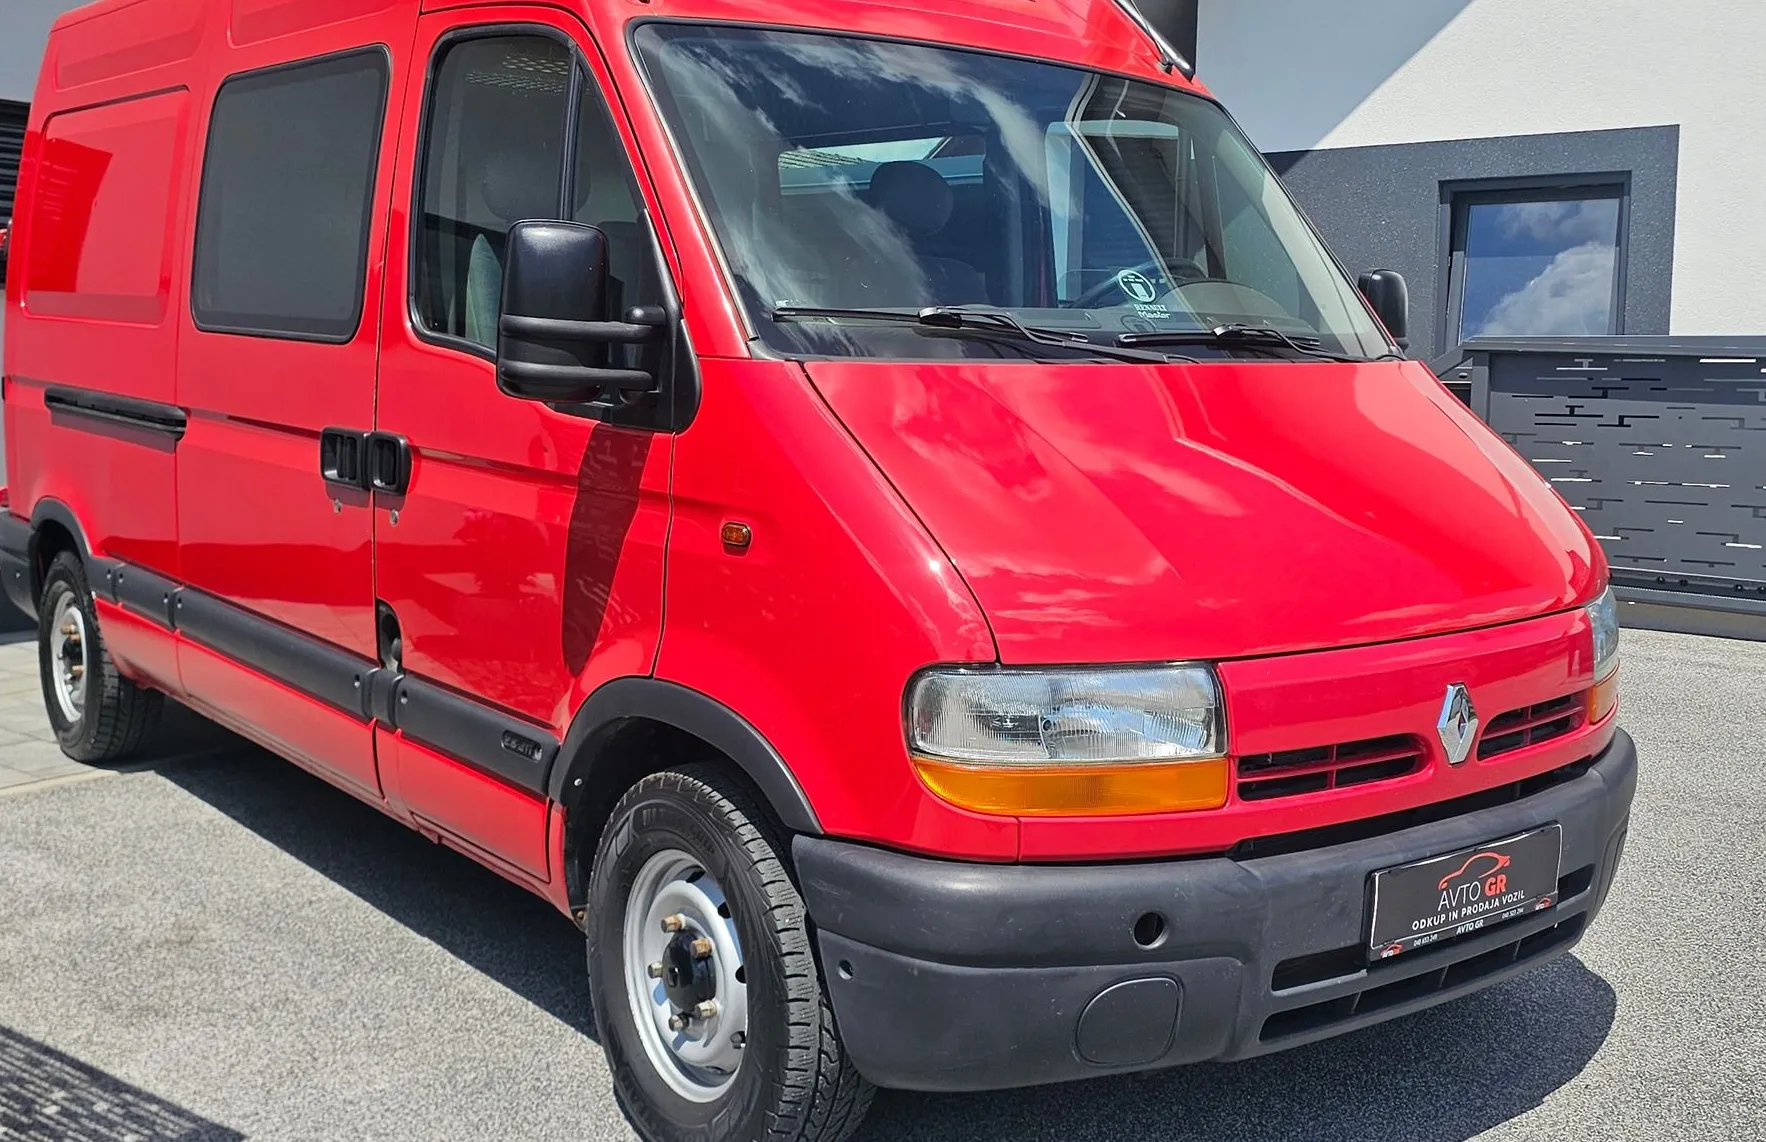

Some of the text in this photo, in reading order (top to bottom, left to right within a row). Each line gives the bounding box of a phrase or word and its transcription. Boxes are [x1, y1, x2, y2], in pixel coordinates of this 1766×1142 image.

[1133, 304, 1168, 312] RENAULT
[1137, 311, 1171, 319] Master
[1438, 874, 1507, 912] AVTO GR
[1411, 913, 1446, 931] ODKUP
[1448, 910, 1458, 922] IN
[1461, 899, 1500, 918] PRODAJA
[1502, 889, 1525, 905] VOZIL
[1456, 919, 1484, 935] AVTO GR
